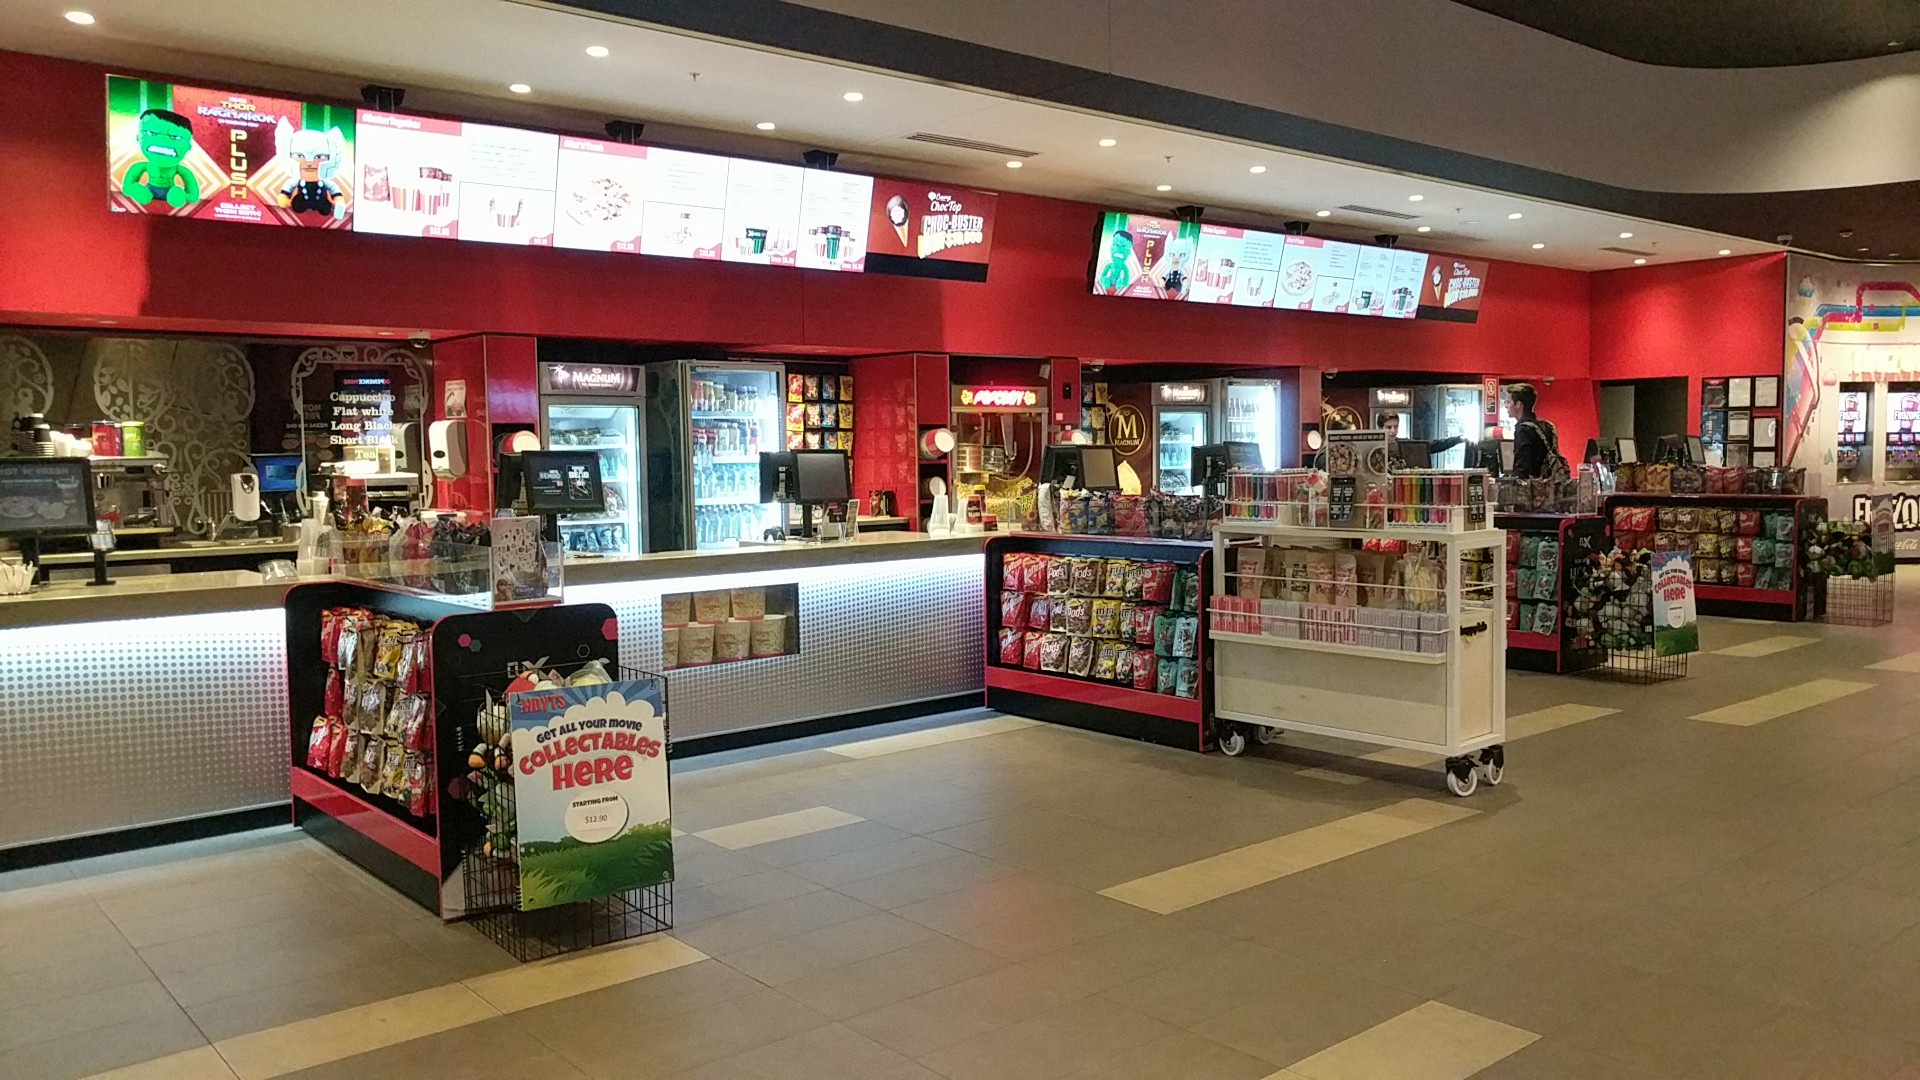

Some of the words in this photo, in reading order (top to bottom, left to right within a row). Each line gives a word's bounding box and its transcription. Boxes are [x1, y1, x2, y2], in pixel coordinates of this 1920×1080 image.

[220, 101, 256, 112] THOR
[197, 105, 277, 124] RAGNAROK
[230, 128, 248, 200] PLUSH
[921, 214, 984, 236] CHOC-BUSTER
[1142, 239, 1155, 284] PLUSH
[572, 371, 622, 383] MAGNUM
[329, 391, 396, 404] Cappuccino
[332, 406, 359, 416] Flat
[361, 406, 394, 416] white
[330, 421, 362, 433] Long
[364, 420, 398, 431] Black
[1116, 414, 1138, 439] M
[329, 435, 364, 445] Short
[1115, 438, 1140, 446] MAGNUM
[354, 449, 377, 459] Tea
[1048, 567, 1065, 578] Pods
[1663, 586, 1686, 602] HERE
[1042, 642, 1060, 654] Pods
[523, 694, 566, 713] HOYTS
[537, 728, 557, 743] GET
[559, 721, 578, 735] ALL
[578, 718, 607, 731] YOUR
[519, 731, 662, 776] COLLECTABLES
[552, 752, 634, 791] HERE
[572, 798, 601, 808] STARTING
[601, 795, 619, 803] FROM
[584, 814, 608, 824] $12.90
